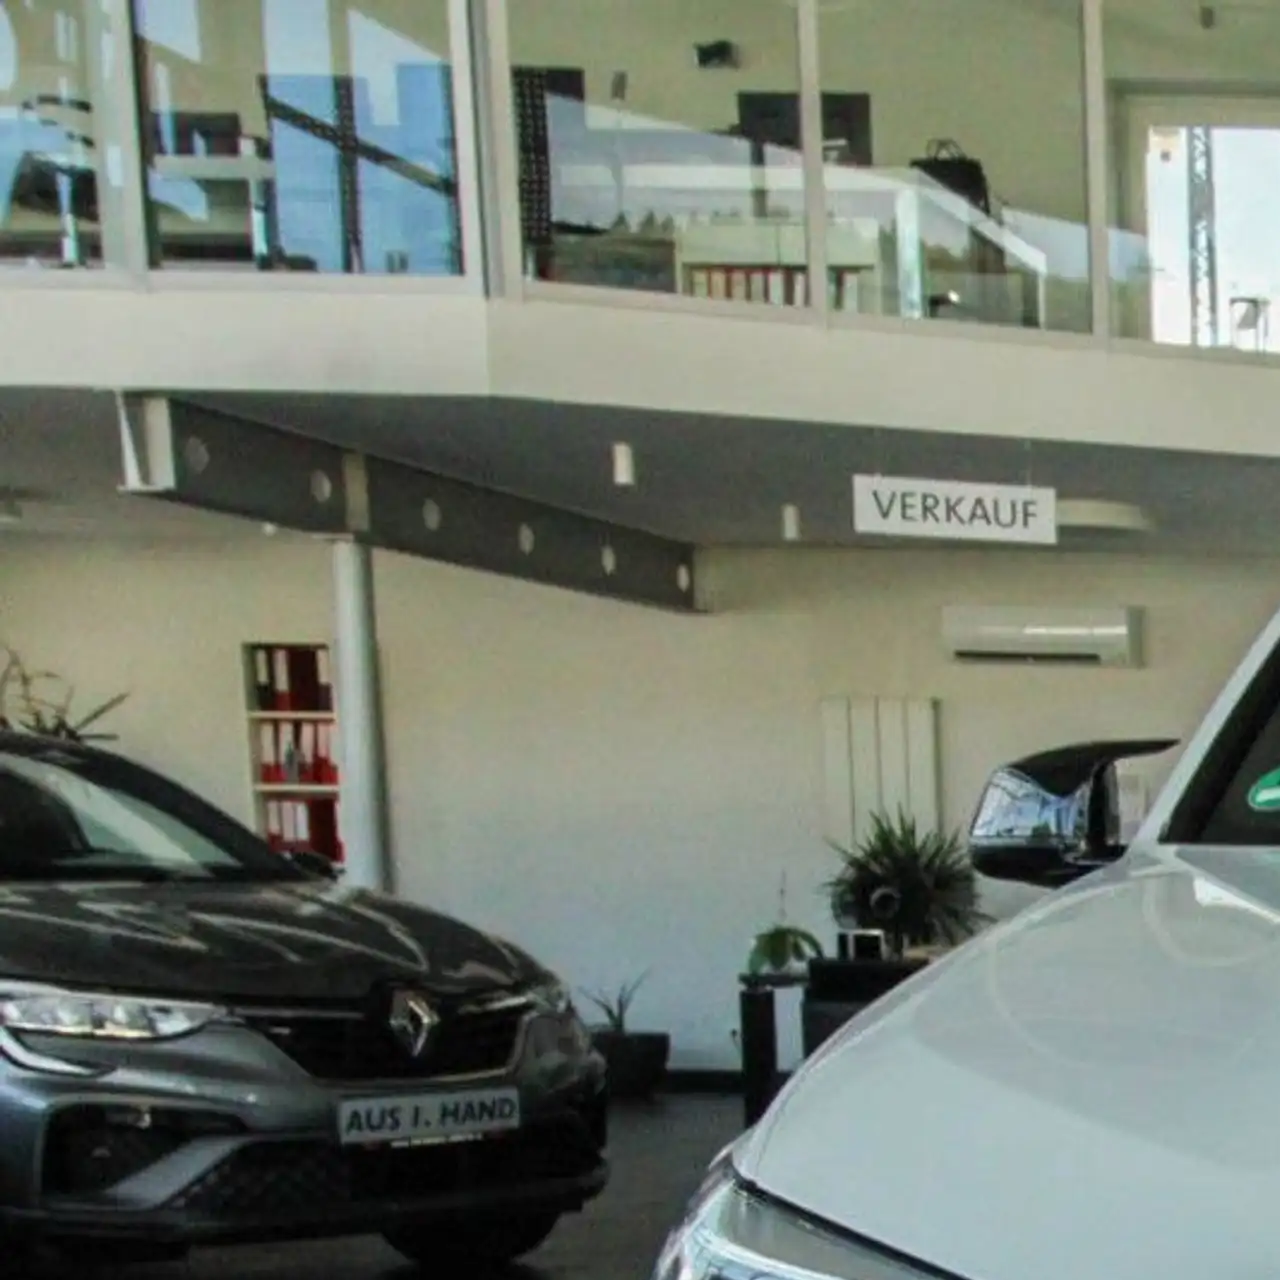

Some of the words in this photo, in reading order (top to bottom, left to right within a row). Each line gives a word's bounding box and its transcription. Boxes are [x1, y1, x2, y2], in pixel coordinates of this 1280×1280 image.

[872, 490, 1037, 528] VERKAUF
[346, 1106, 401, 1133] AUS
[439, 1097, 516, 1125] HAND
